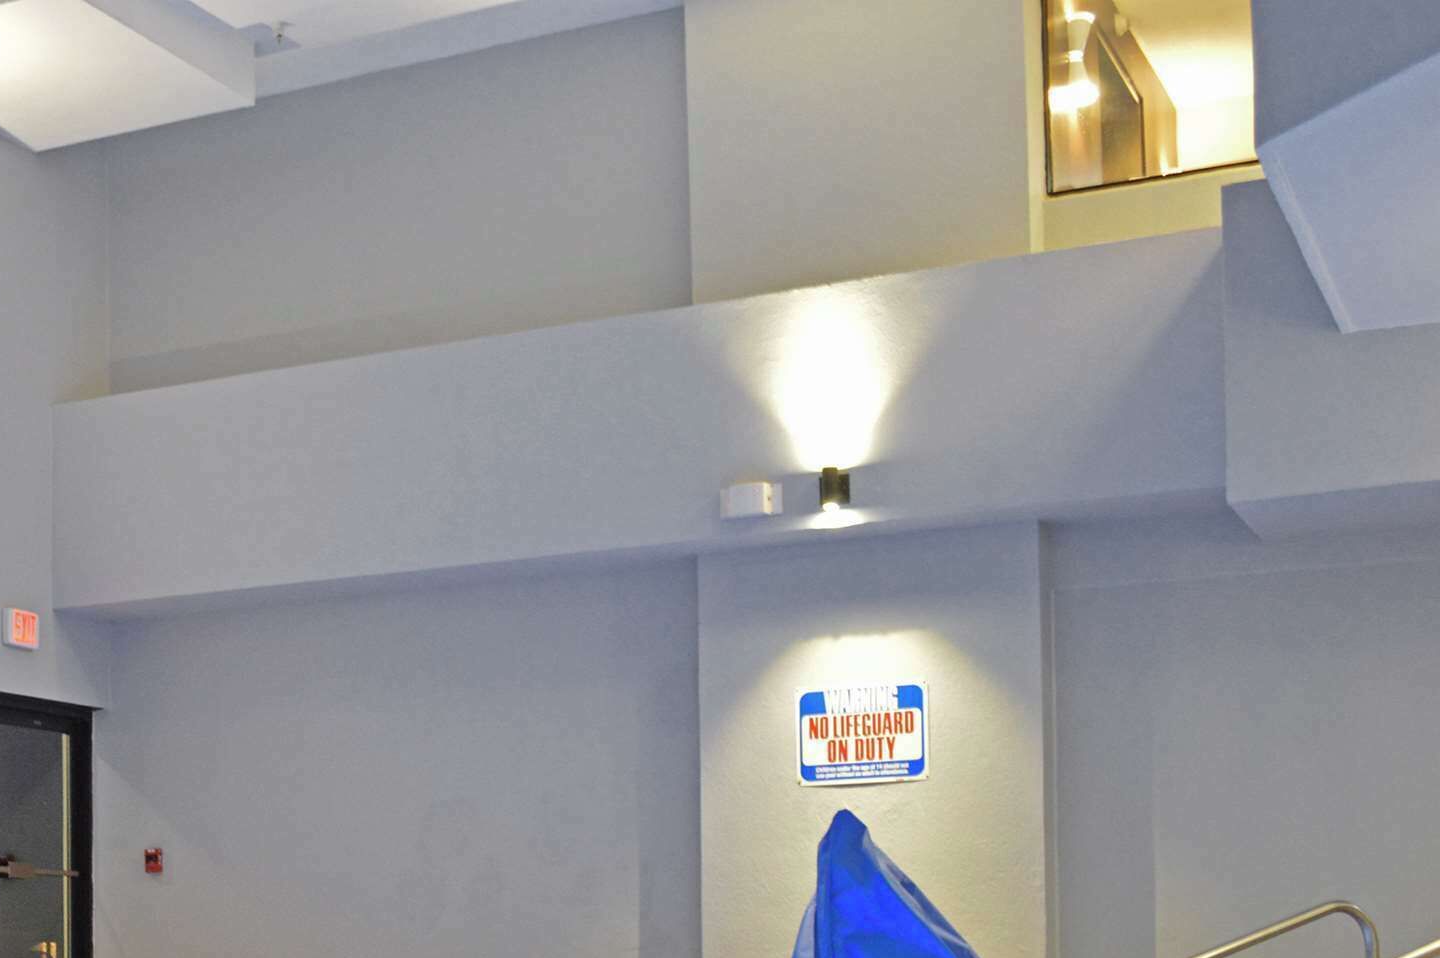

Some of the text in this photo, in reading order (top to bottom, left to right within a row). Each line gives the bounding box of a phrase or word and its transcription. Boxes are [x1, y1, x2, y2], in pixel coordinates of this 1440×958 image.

[14, 611, 37, 643] EXIT
[809, 711, 914, 739] NO LIFEGUARD
[827, 737, 896, 763] ON DUTY
